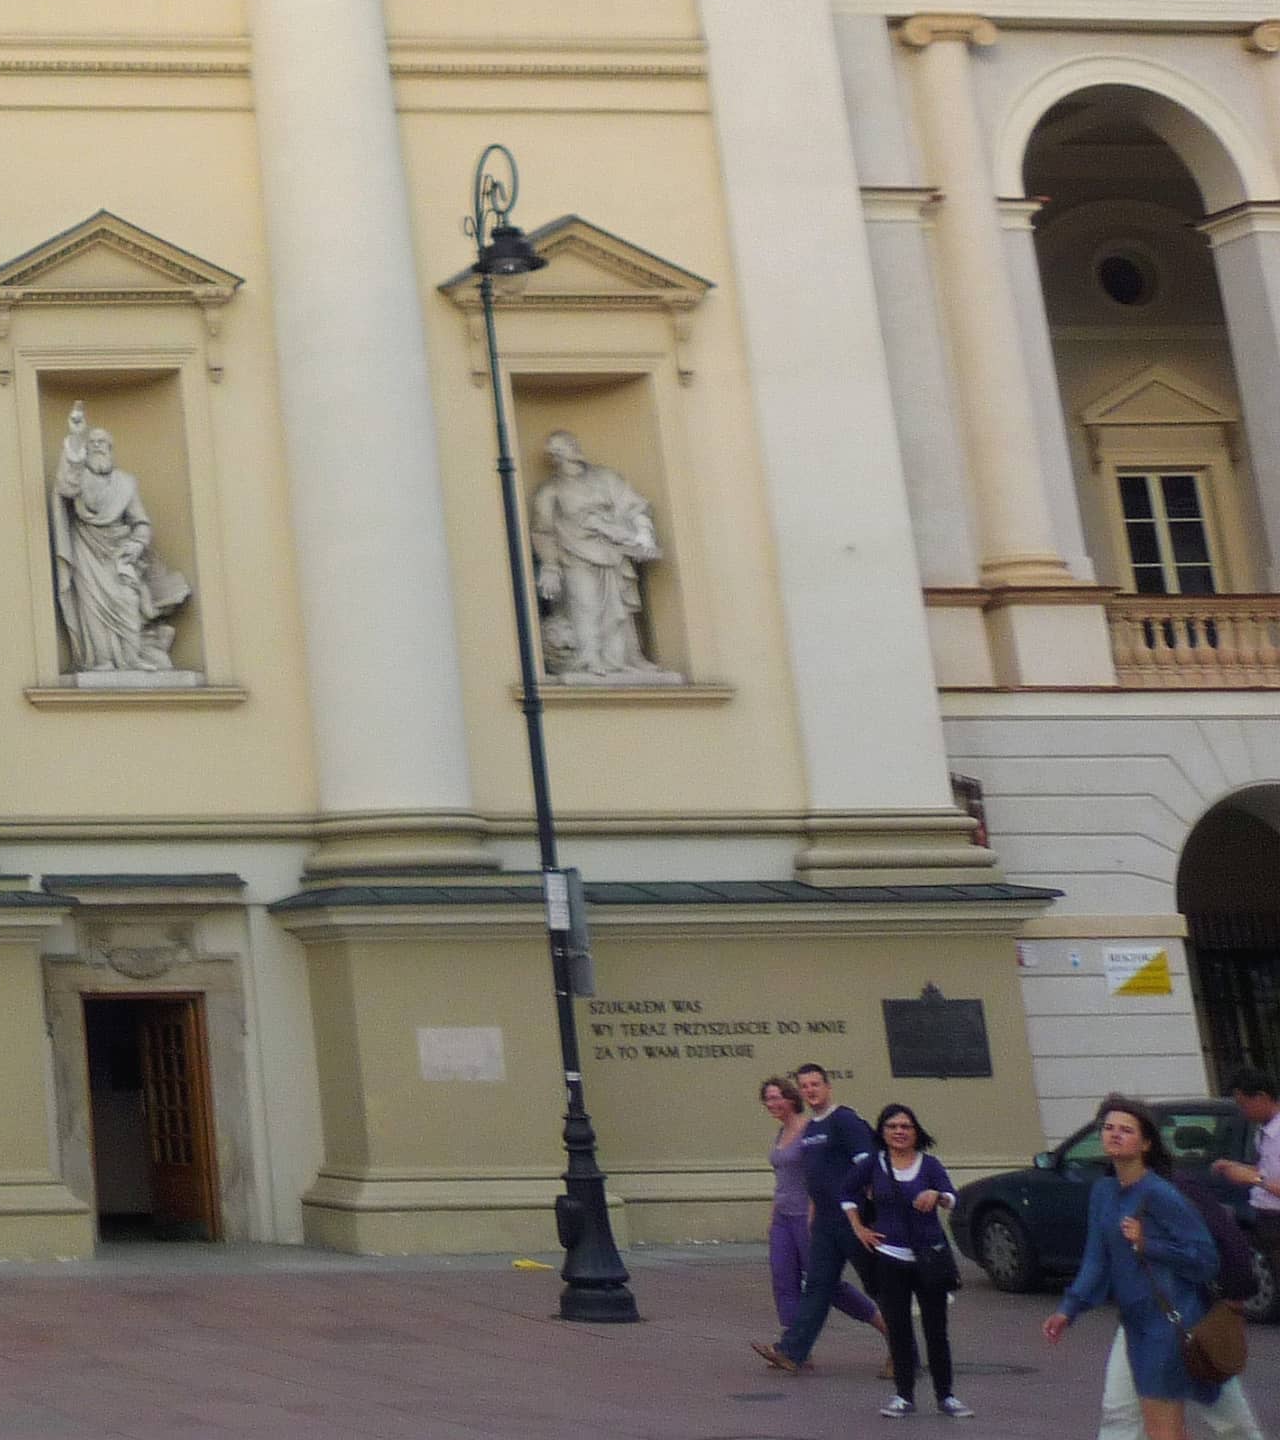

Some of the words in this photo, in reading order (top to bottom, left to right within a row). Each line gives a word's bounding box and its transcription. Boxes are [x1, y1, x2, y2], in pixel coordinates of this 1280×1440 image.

[671, 1000, 703, 1013] WAS
[620, 1023, 666, 1036] TERAZ
[777, 1020, 801, 1034] DO
[593, 1045, 615, 1060] ZA
[617, 1045, 639, 1059] TO
[643, 1045, 680, 1059] WAM
